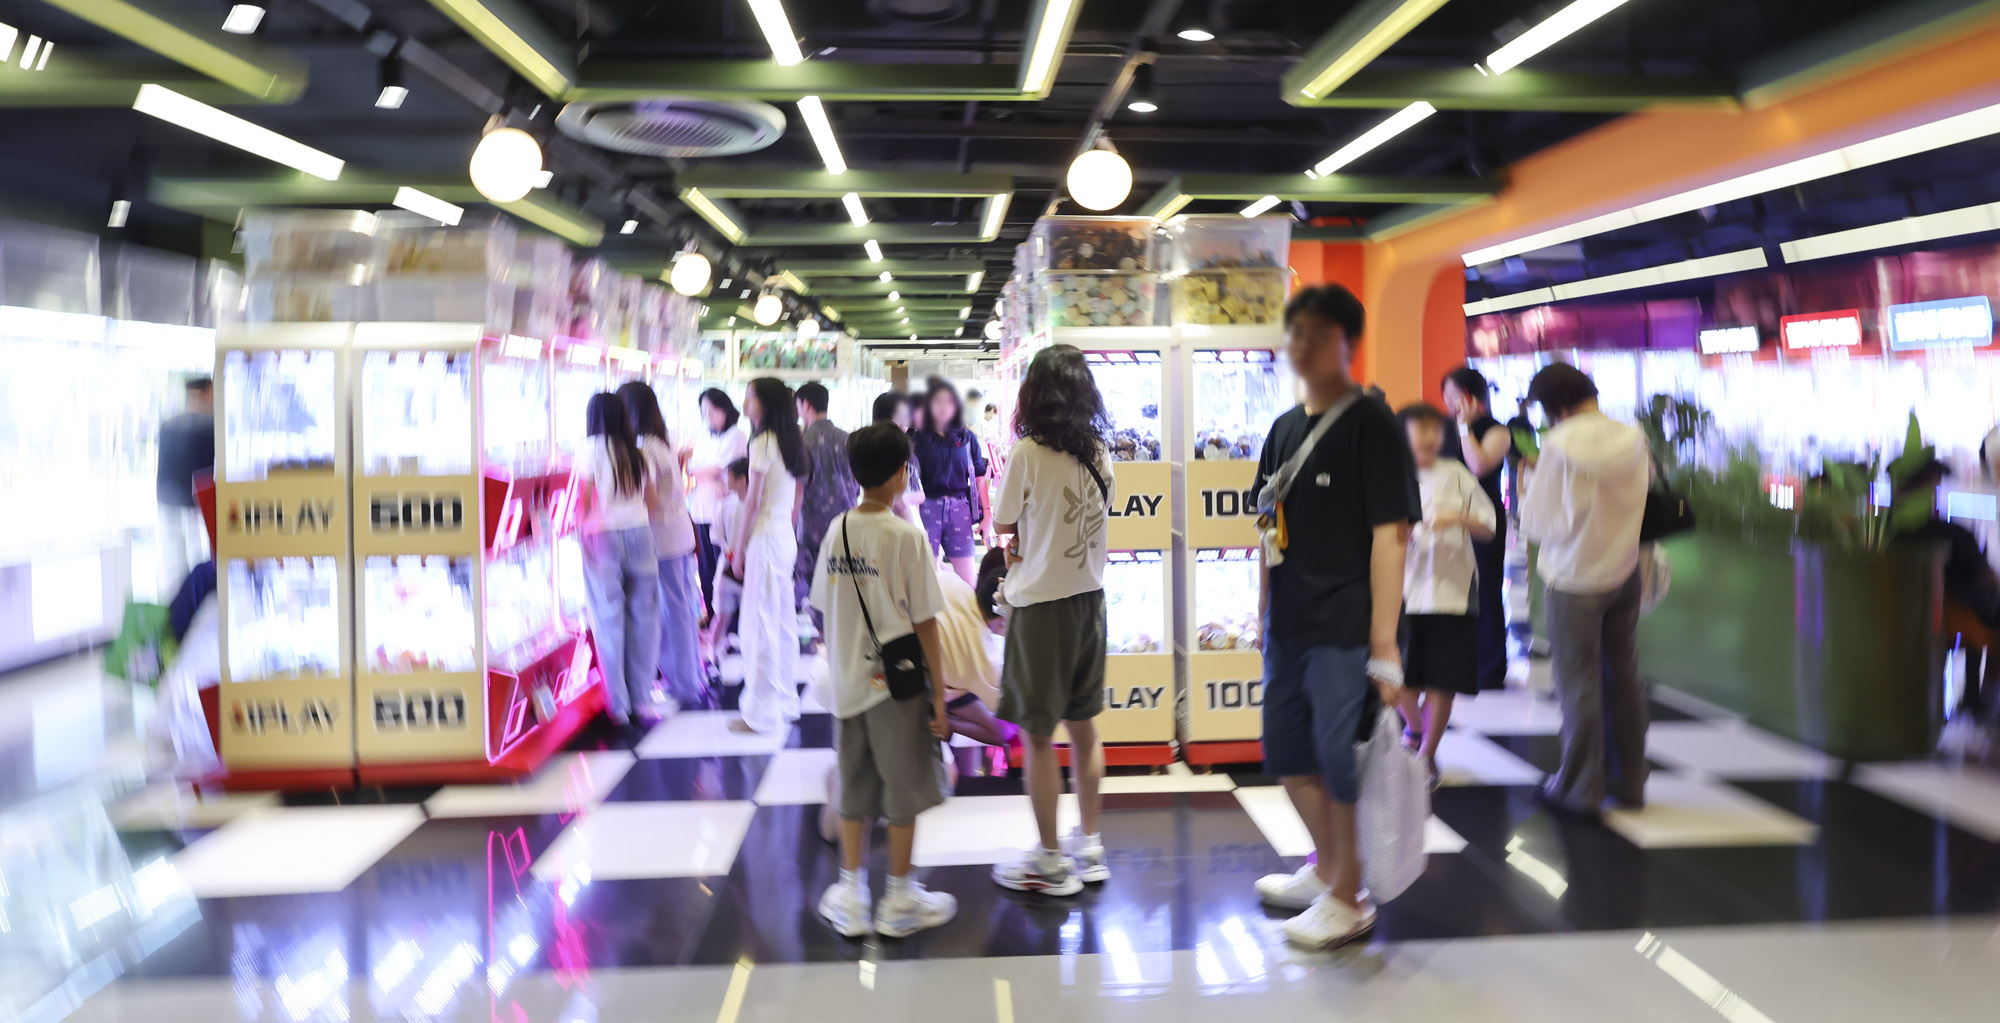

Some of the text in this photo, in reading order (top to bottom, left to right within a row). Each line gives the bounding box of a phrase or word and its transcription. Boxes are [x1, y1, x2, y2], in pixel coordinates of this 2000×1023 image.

[1107, 495, 1163, 517] LAY
[1106, 686, 1166, 709] LAY
[1205, 681, 1264, 709] 100
